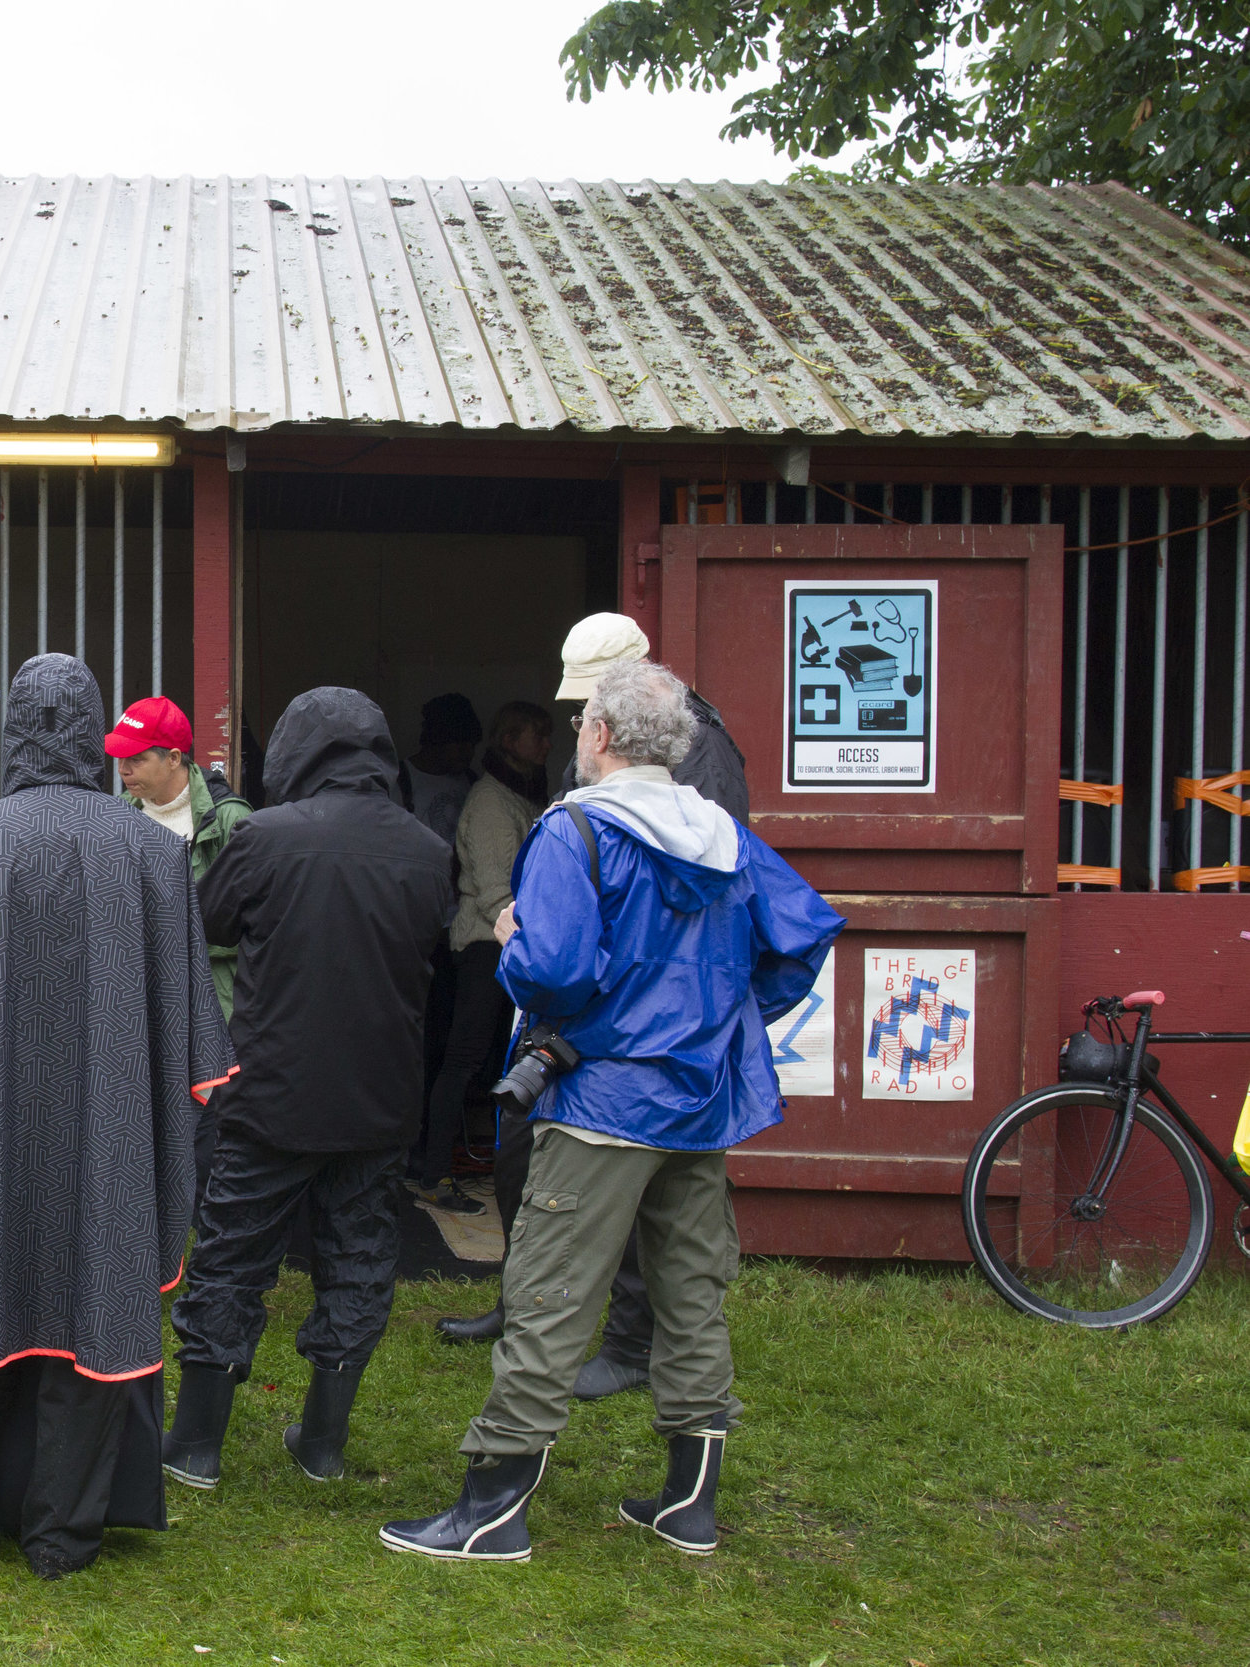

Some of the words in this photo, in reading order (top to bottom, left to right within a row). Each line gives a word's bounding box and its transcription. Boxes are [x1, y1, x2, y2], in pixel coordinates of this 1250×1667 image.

[123, 717, 144, 729] CAMP
[838, 748, 879, 763] ACCESS
[797, 765, 804, 774] TO
[805, 765, 834, 774] EDUCATION,
[836, 765, 854, 774] SOCIAL
[855, 765, 880, 774] SERVICES,
[881, 765, 899, 774] LABOR
[899, 765, 920, 774] MARKET
[872, 956, 917, 974] THE
[885, 957, 969, 992] BRIDGE
[871, 1069, 967, 1094] RADIO
